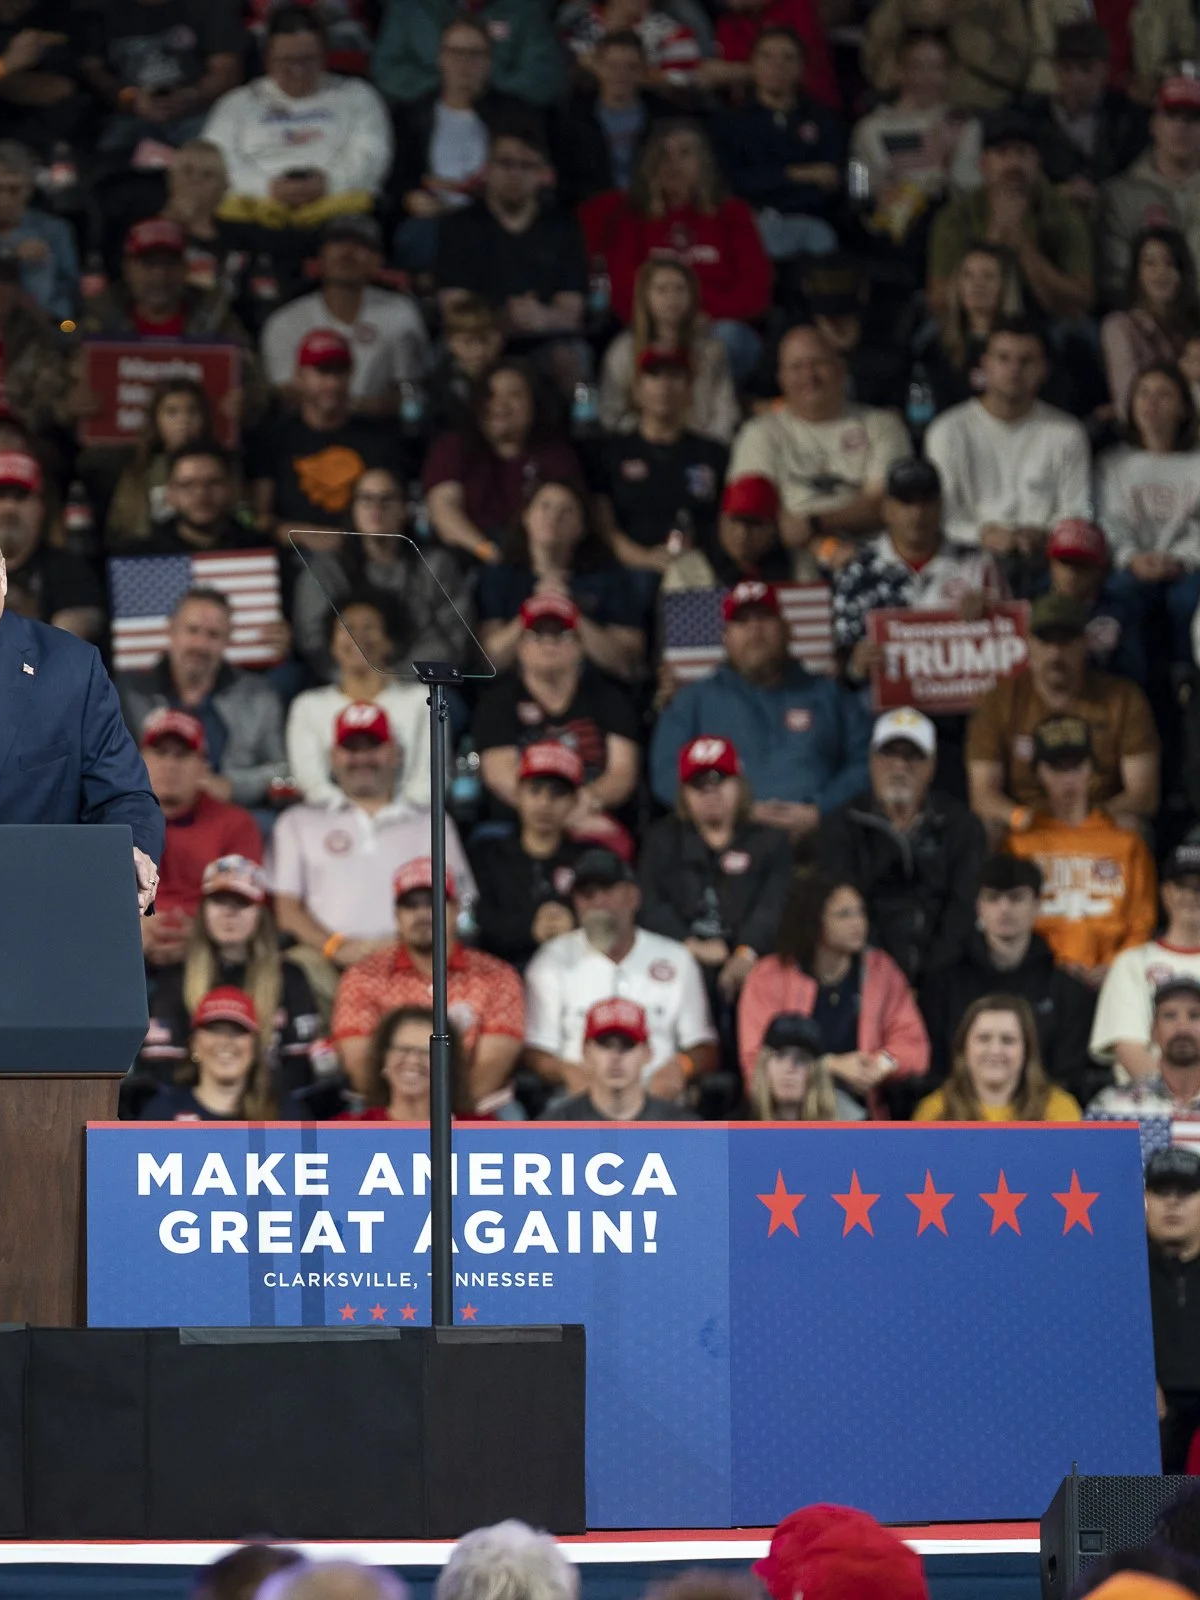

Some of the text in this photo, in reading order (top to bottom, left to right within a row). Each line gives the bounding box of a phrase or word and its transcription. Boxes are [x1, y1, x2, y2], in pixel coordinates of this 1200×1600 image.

[884, 636, 1028, 682] TRUMP
[137, 1153, 329, 1195] MAKE
[159, 1210, 384, 1254] GREAT
[263, 1272, 554, 1289] CLARKSVILLE, NNESSEE
